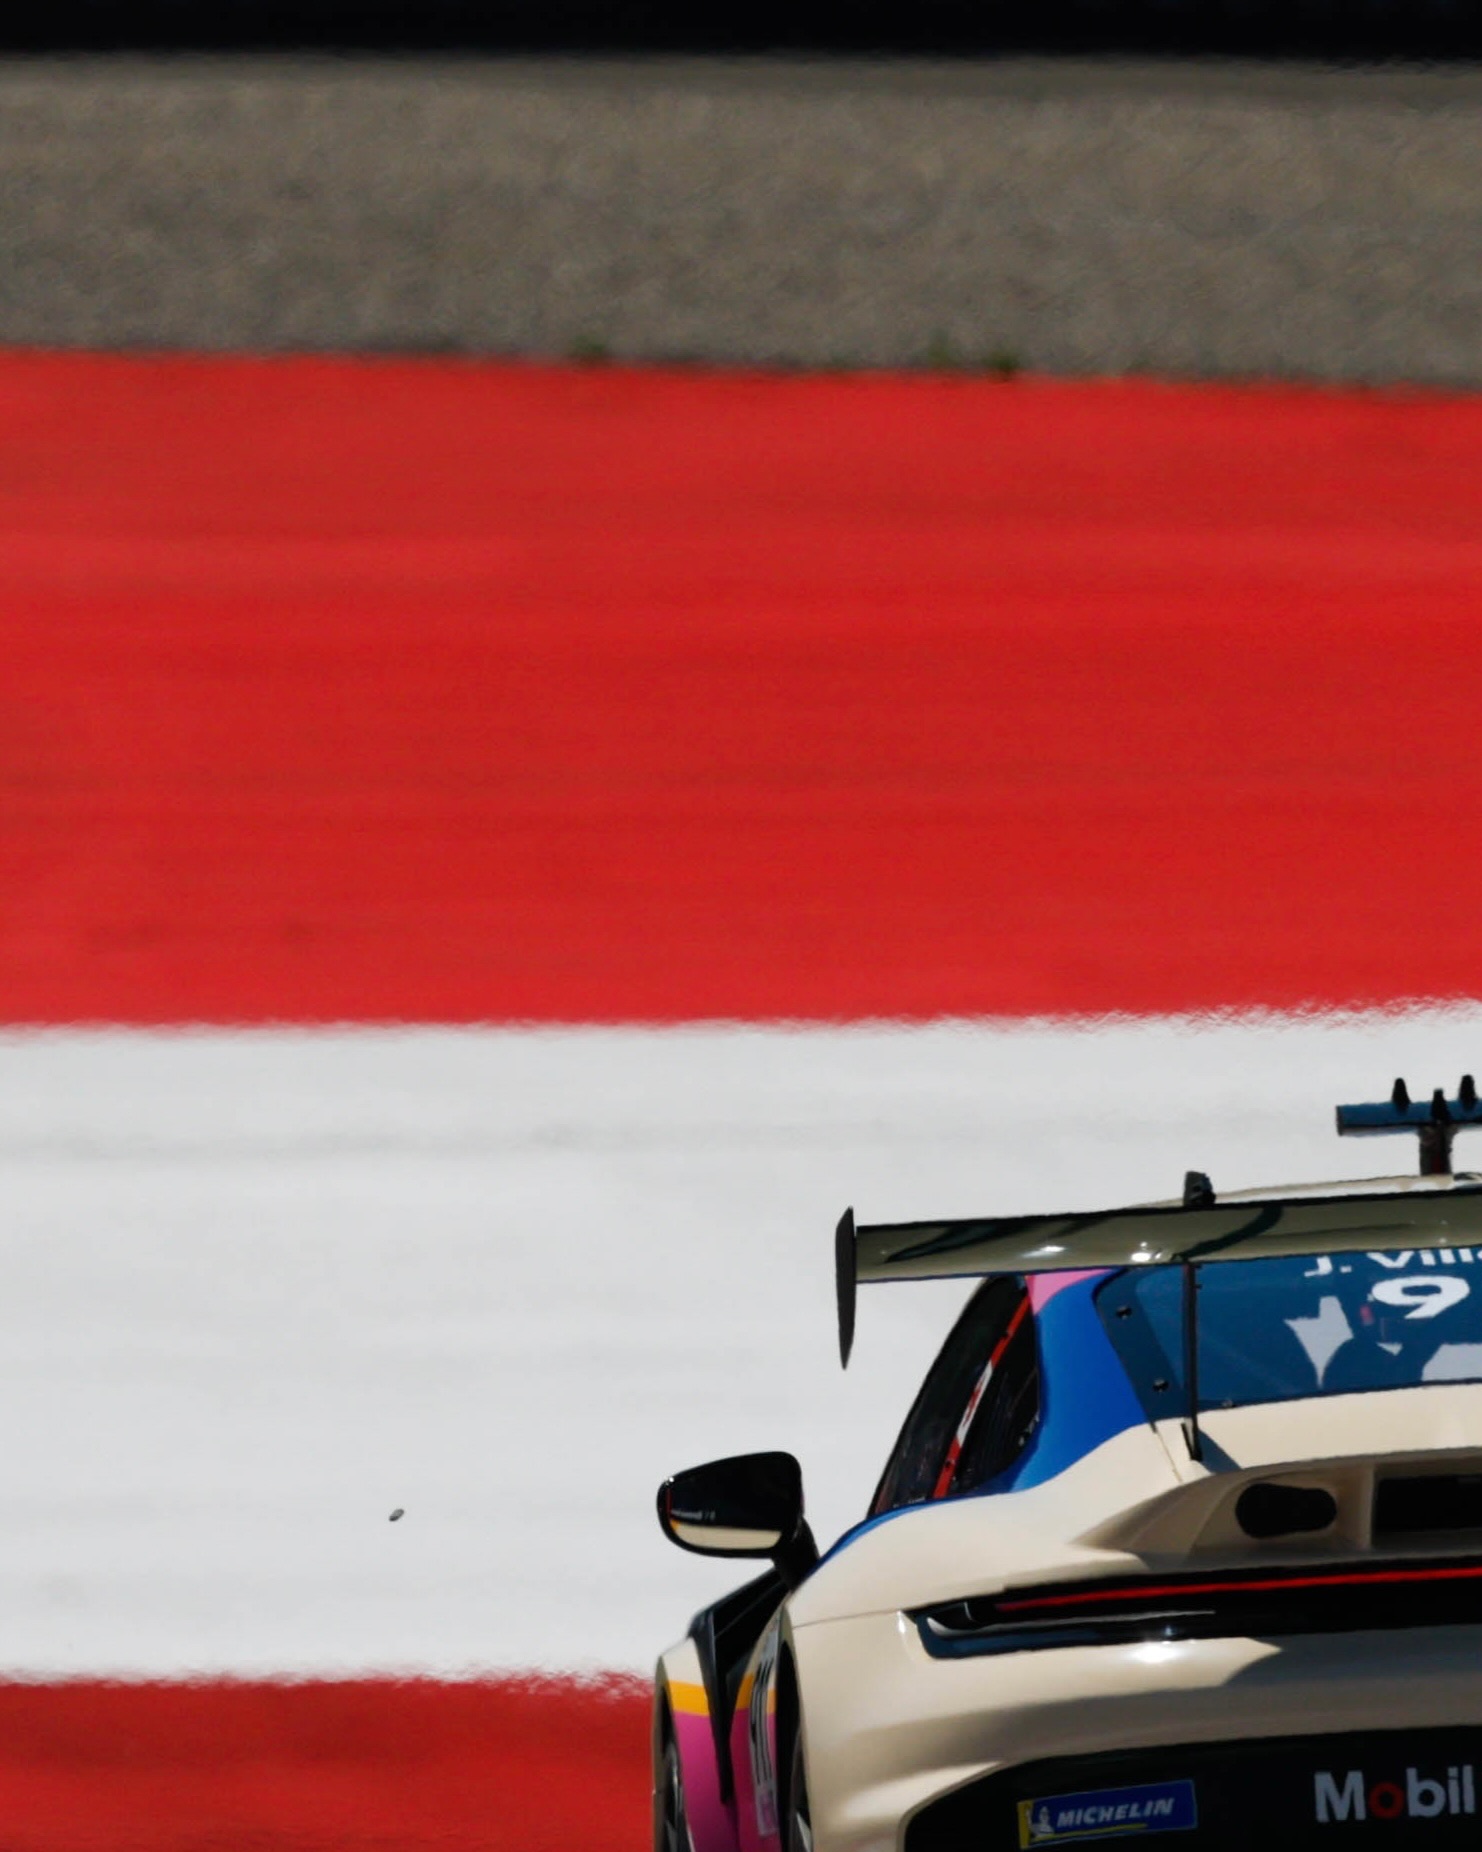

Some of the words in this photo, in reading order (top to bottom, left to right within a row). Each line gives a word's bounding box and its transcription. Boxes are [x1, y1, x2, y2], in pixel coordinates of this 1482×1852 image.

[1303, 1256, 1352, 1278] J.
[1314, 1764, 1477, 1823] Mobil
[1055, 1796, 1175, 1829] MICHELIN
